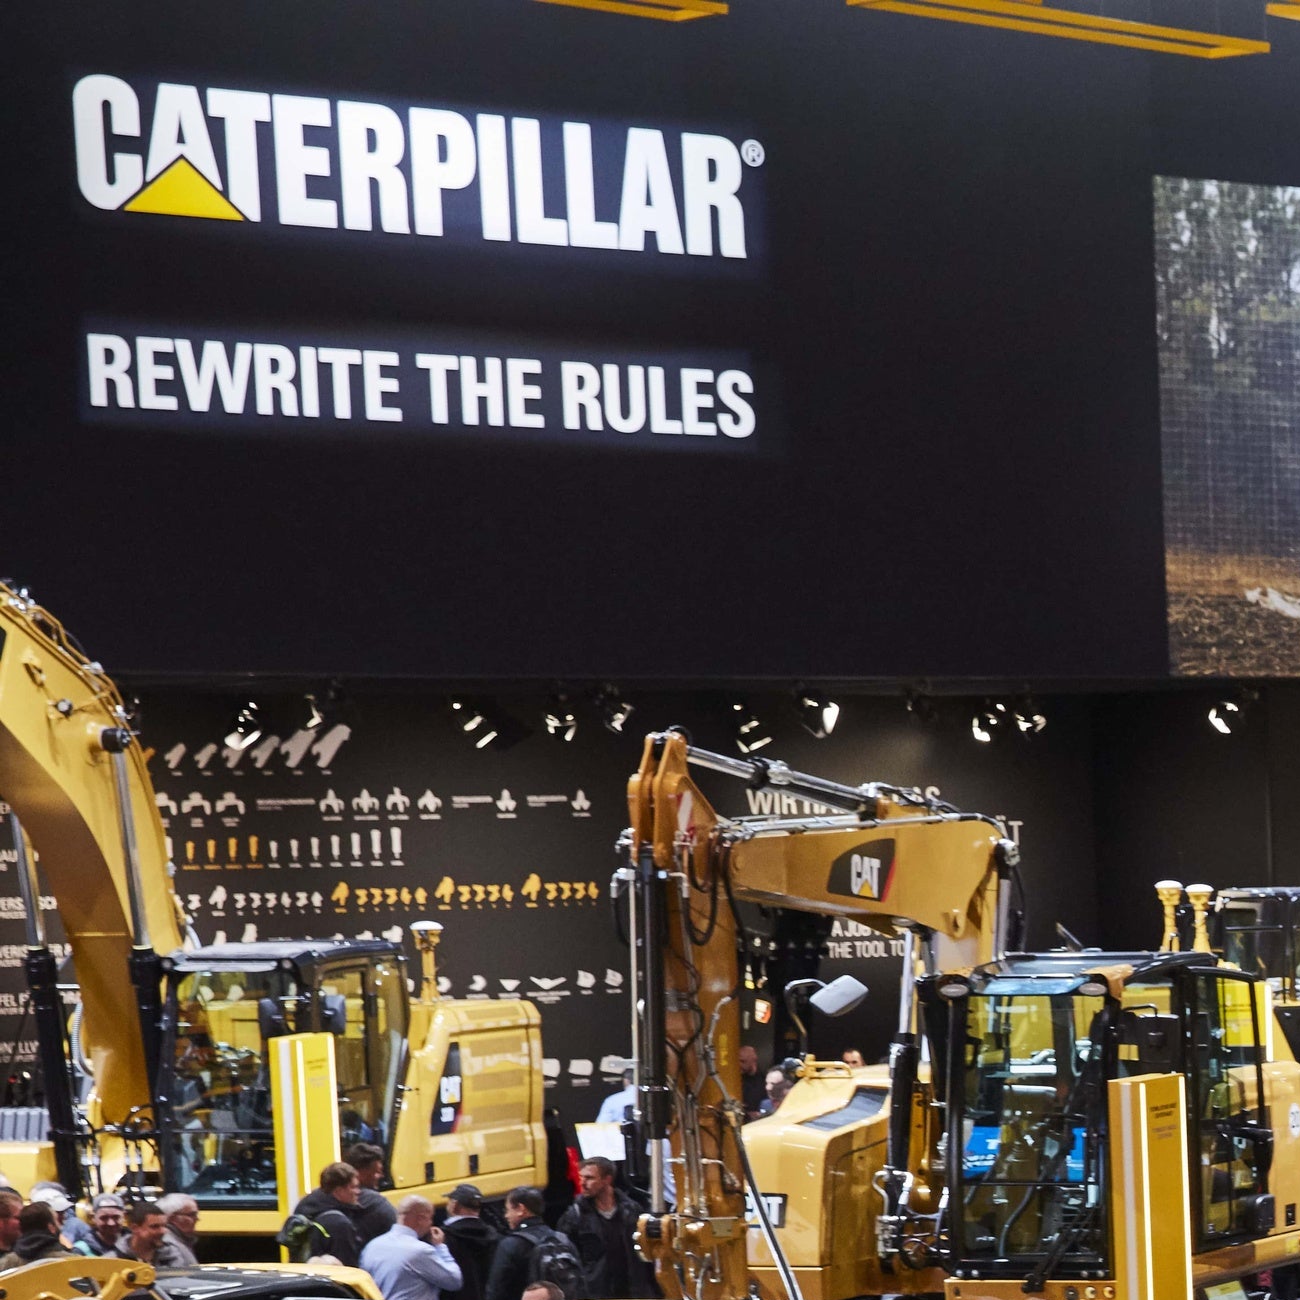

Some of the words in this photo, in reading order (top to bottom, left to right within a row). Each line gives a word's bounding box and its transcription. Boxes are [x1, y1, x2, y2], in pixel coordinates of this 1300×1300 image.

[86, 332, 404, 423] REWRITE
[416, 353, 546, 429] THE
[561, 360, 757, 439] RULES
[745, 787, 799, 814] WIR
[851, 854, 881, 899] CAT
[827, 941, 853, 958] THE
[853, 940, 889, 958] TOOL
